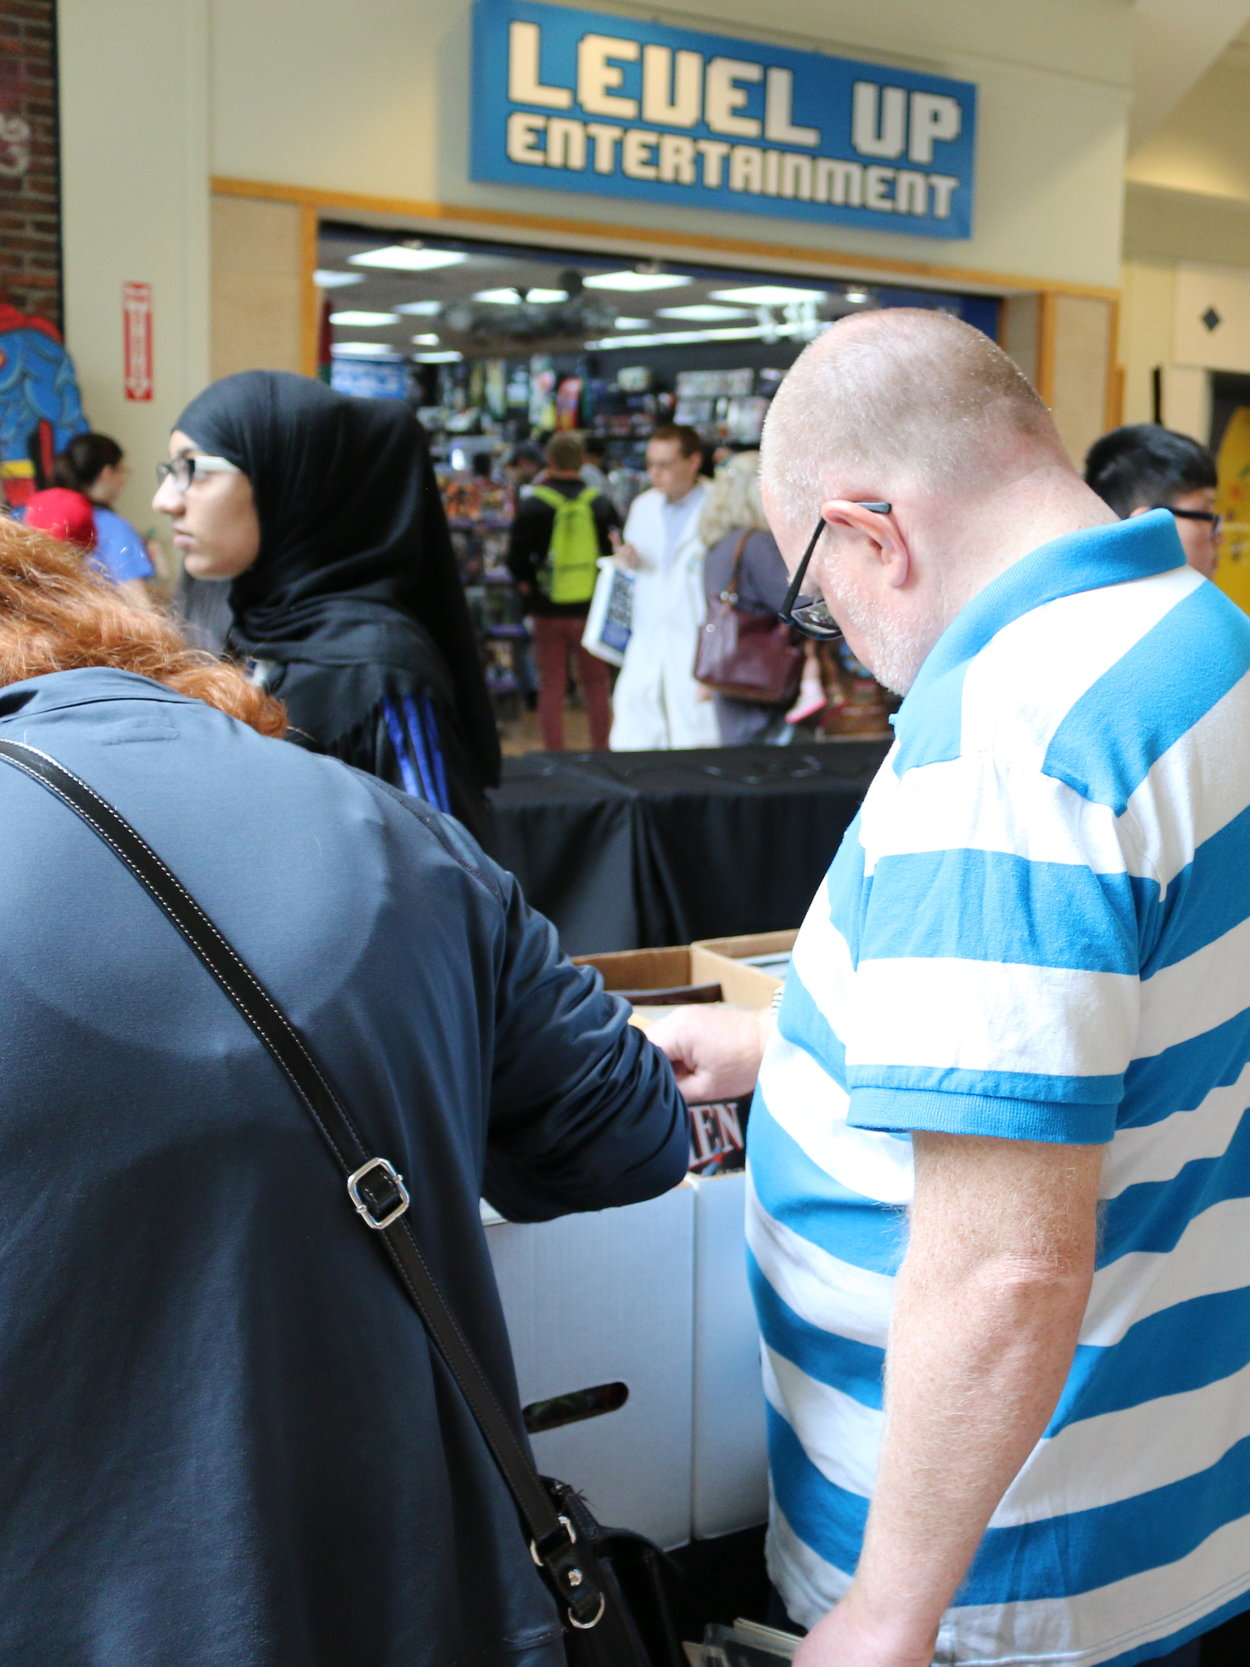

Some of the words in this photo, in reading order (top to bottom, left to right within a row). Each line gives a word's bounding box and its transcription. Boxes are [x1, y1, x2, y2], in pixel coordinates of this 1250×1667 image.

[507, 20, 820, 147] LEVEL
[851, 80, 963, 164] UP
[506, 111, 960, 220] ENTERTAINMENT
[688, 1102, 745, 1169] EN
